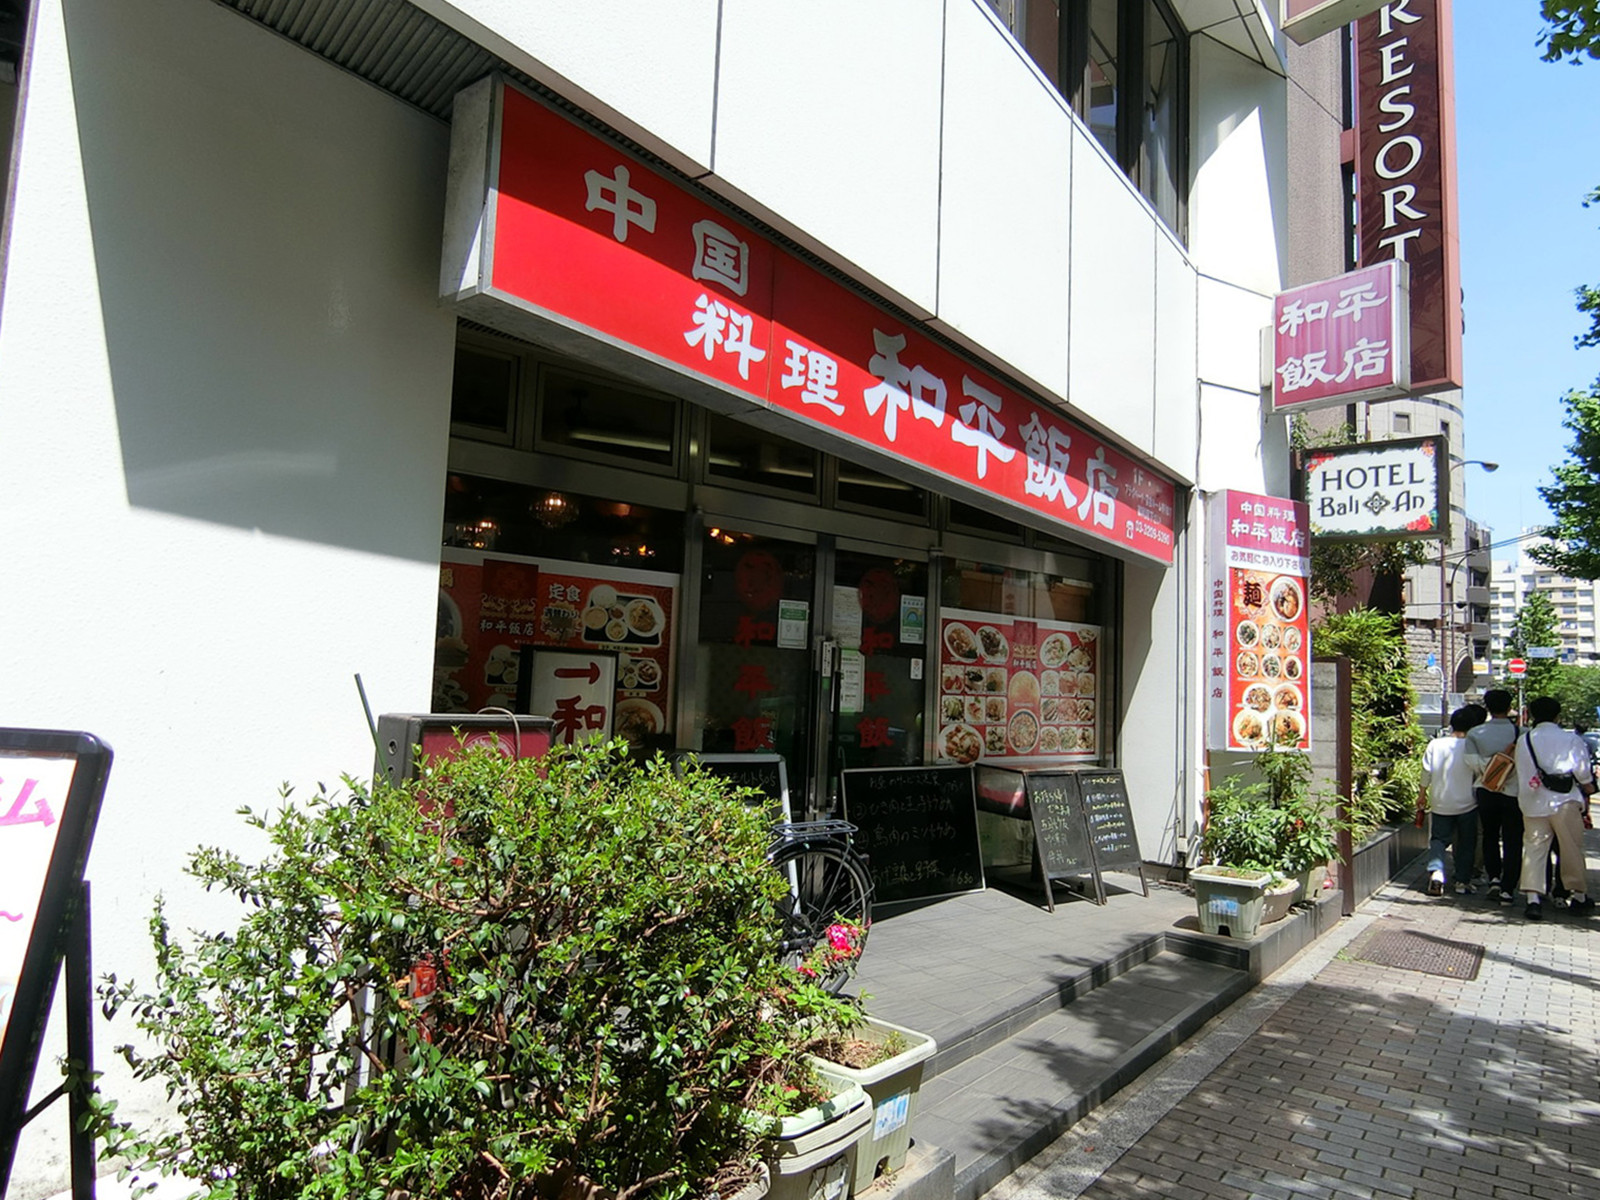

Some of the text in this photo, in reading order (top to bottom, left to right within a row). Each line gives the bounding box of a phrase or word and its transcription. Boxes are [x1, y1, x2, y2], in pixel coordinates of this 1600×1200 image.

[1374, 0, 1428, 260] RESORT
[584, 165, 749, 297] 中国
[1278, 281, 1388, 338] 和平
[684, 293, 845, 417] 料理
[1277, 339, 1390, 394] 飯店
[864, 328, 1119, 530] 和平飯店
[1321, 462, 1425, 492] HOTEL
[1240, 501, 1296, 522] 中国料理
[1317, 490, 1425, 518] Bali An
[1231, 518, 1305, 548] 和平飯店
[549, 584, 581, 602] 定食
[1213, 579, 1224, 617] 中国料理
[480, 619, 534, 636] 和平飯店
[1211, 629, 1224, 698] 和平飯店
[551, 695, 606, 745] 和
